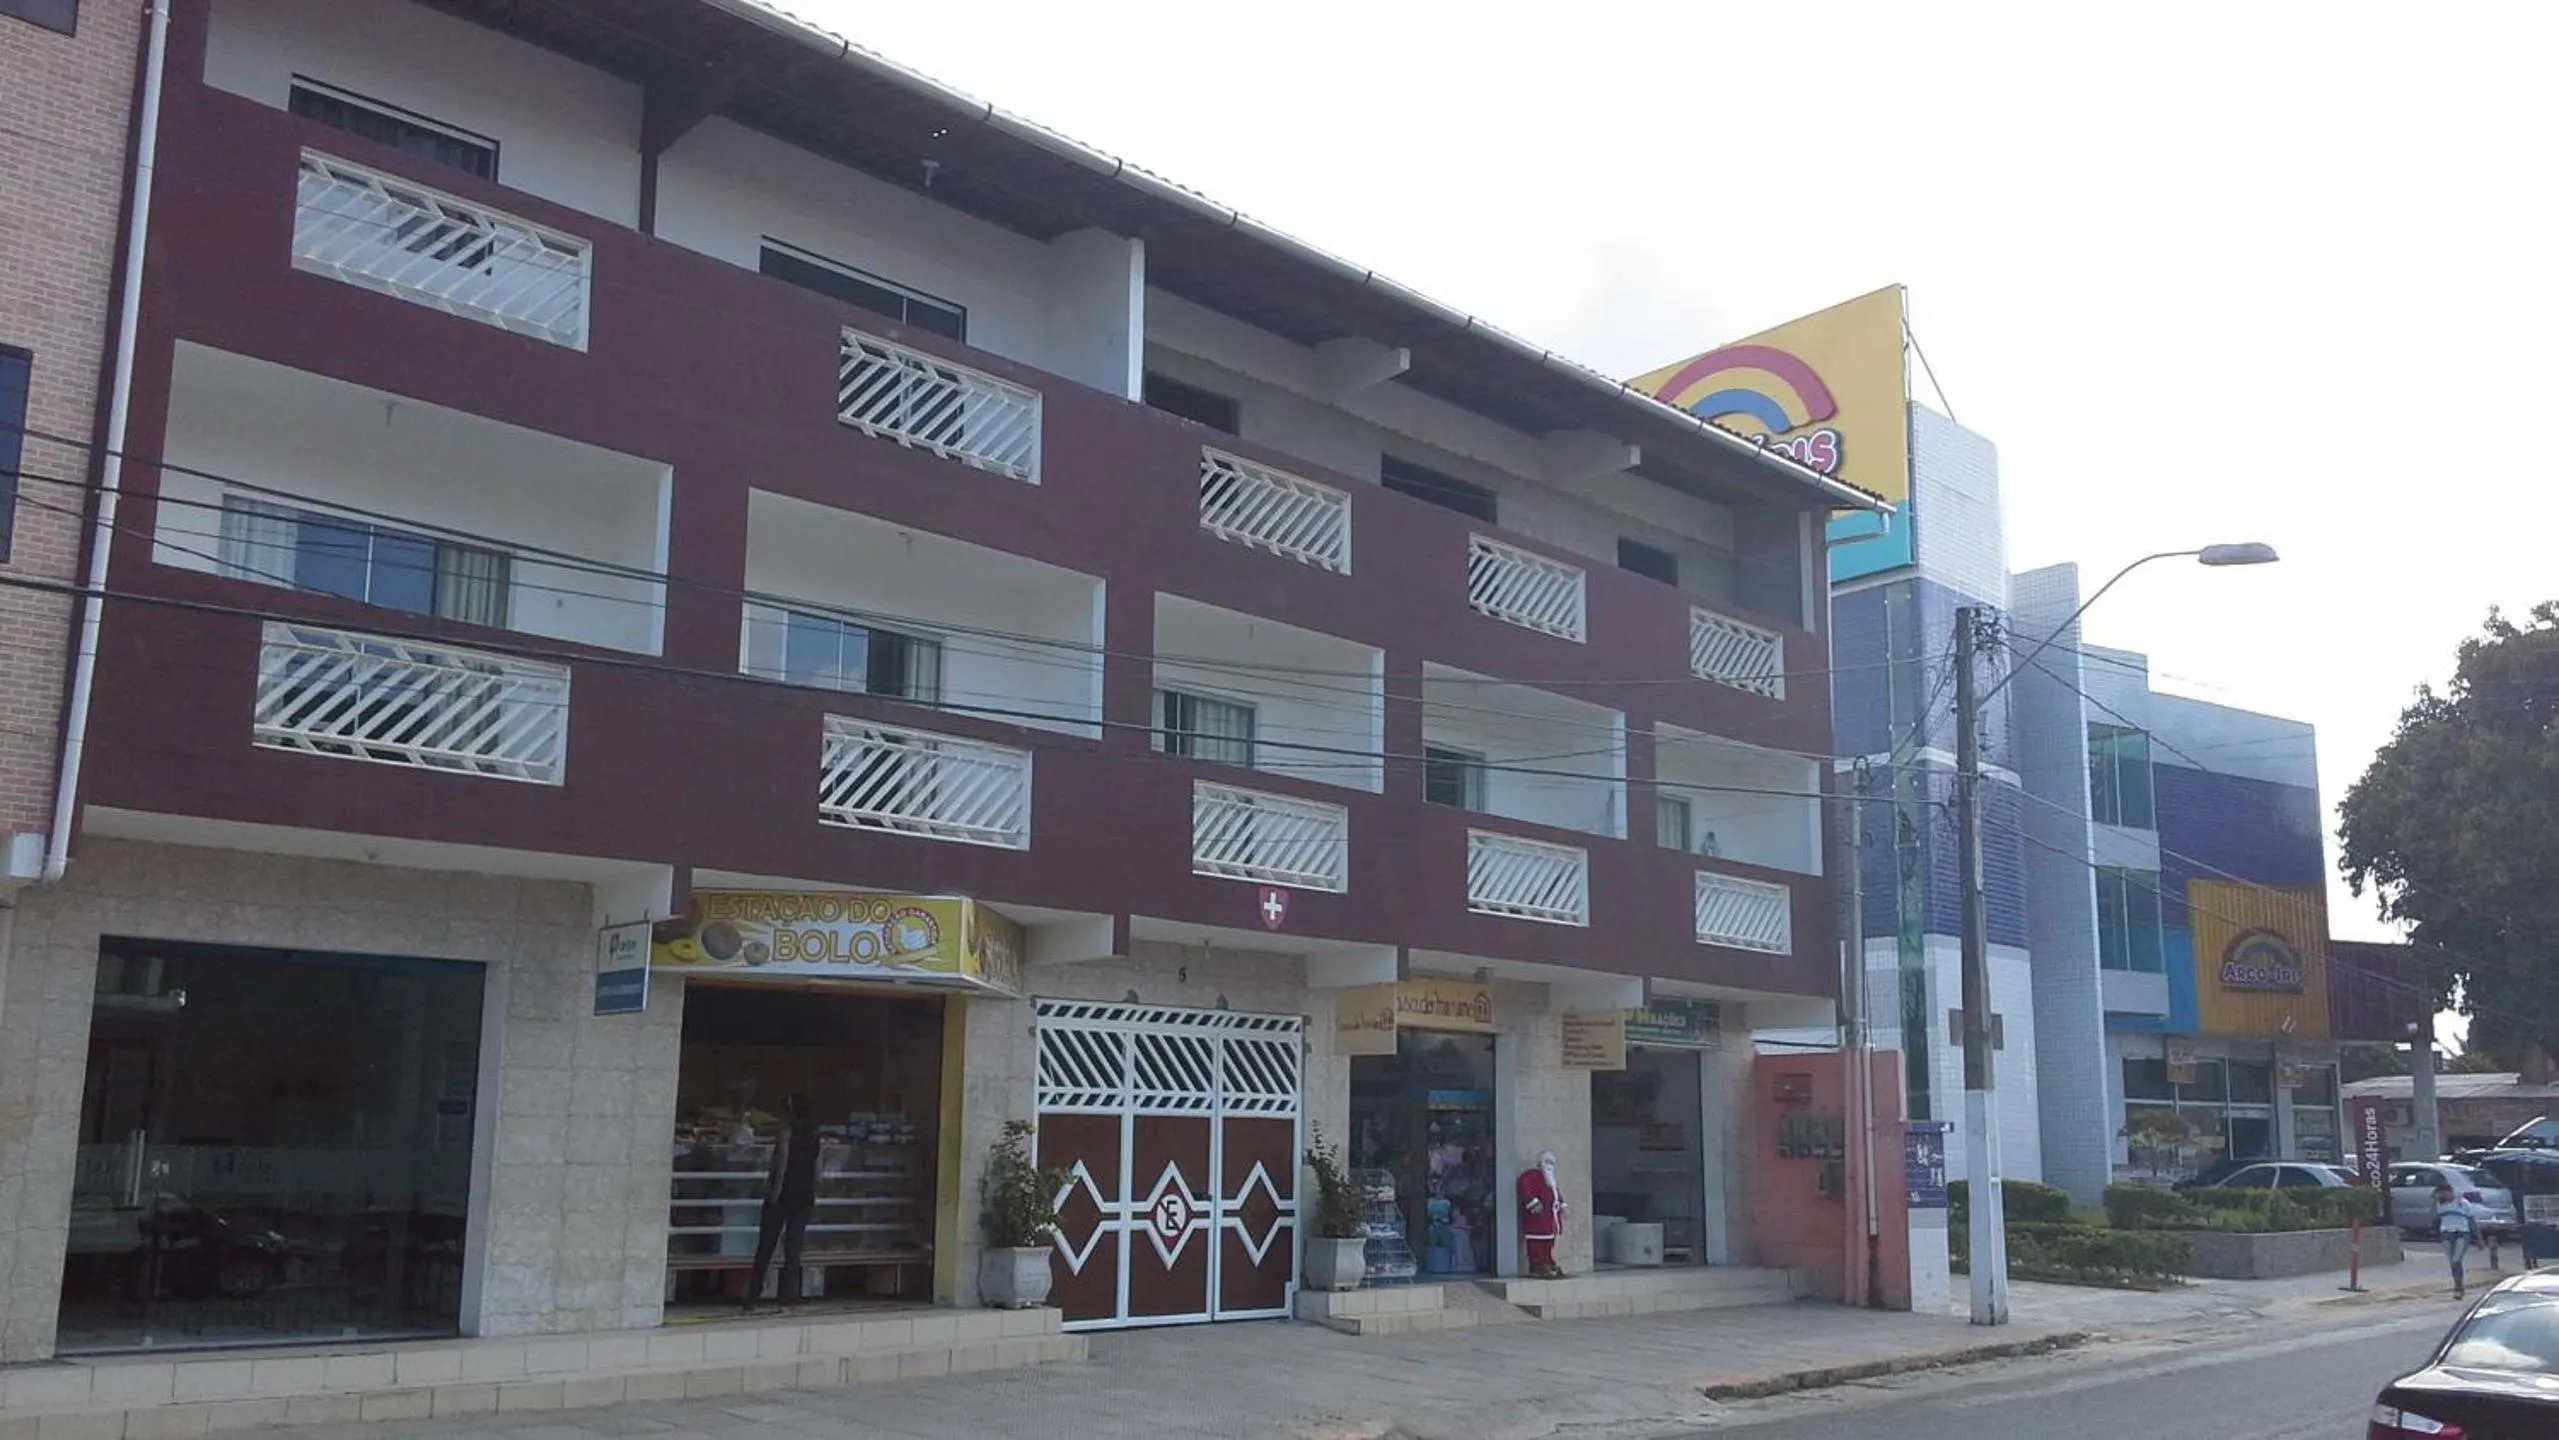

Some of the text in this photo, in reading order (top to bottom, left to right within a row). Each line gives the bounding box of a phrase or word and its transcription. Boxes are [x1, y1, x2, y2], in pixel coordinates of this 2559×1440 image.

[847, 897, 892, 924] DO
[771, 928, 882, 964] BOLO
[1165, 1200, 1178, 1230] E
